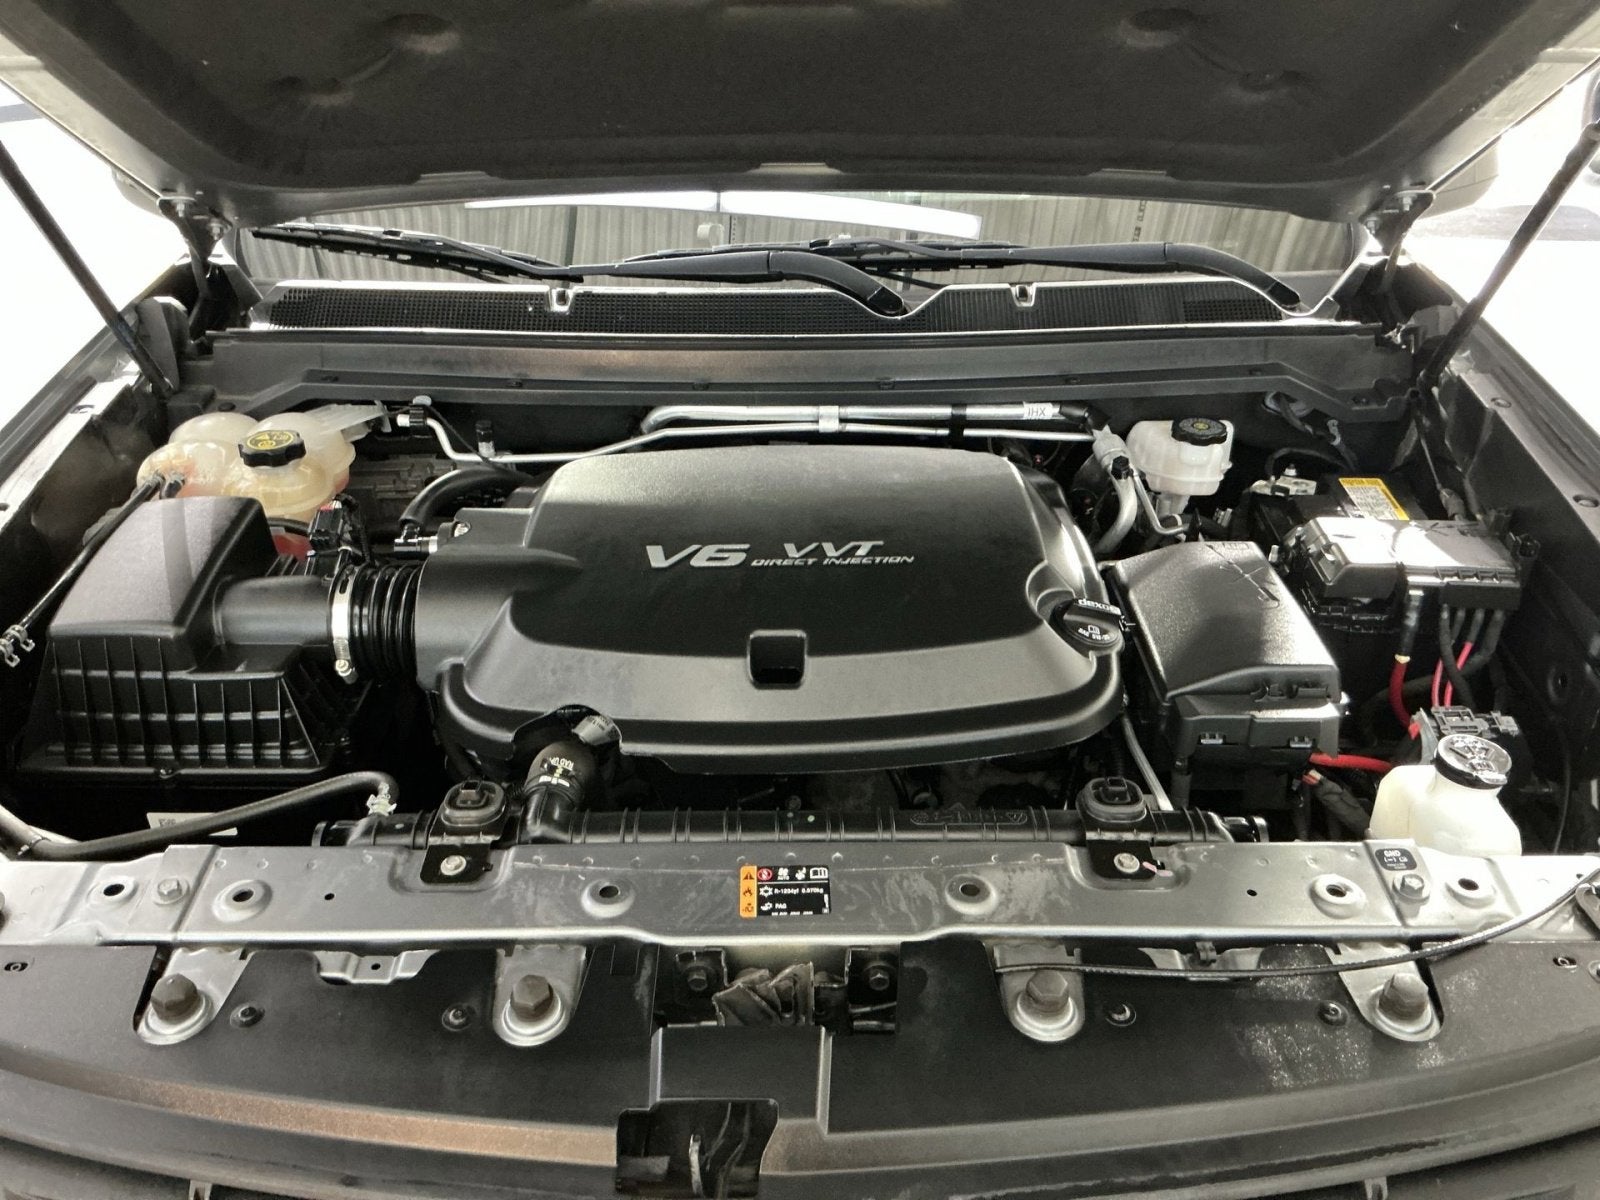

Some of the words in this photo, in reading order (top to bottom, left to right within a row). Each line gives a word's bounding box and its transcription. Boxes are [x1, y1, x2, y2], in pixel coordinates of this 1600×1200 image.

[645, 543, 751, 568] V6
[783, 540, 884, 558] VVT
[751, 558, 818, 567] DIRECT
[822, 555, 915, 566] INJECTION
